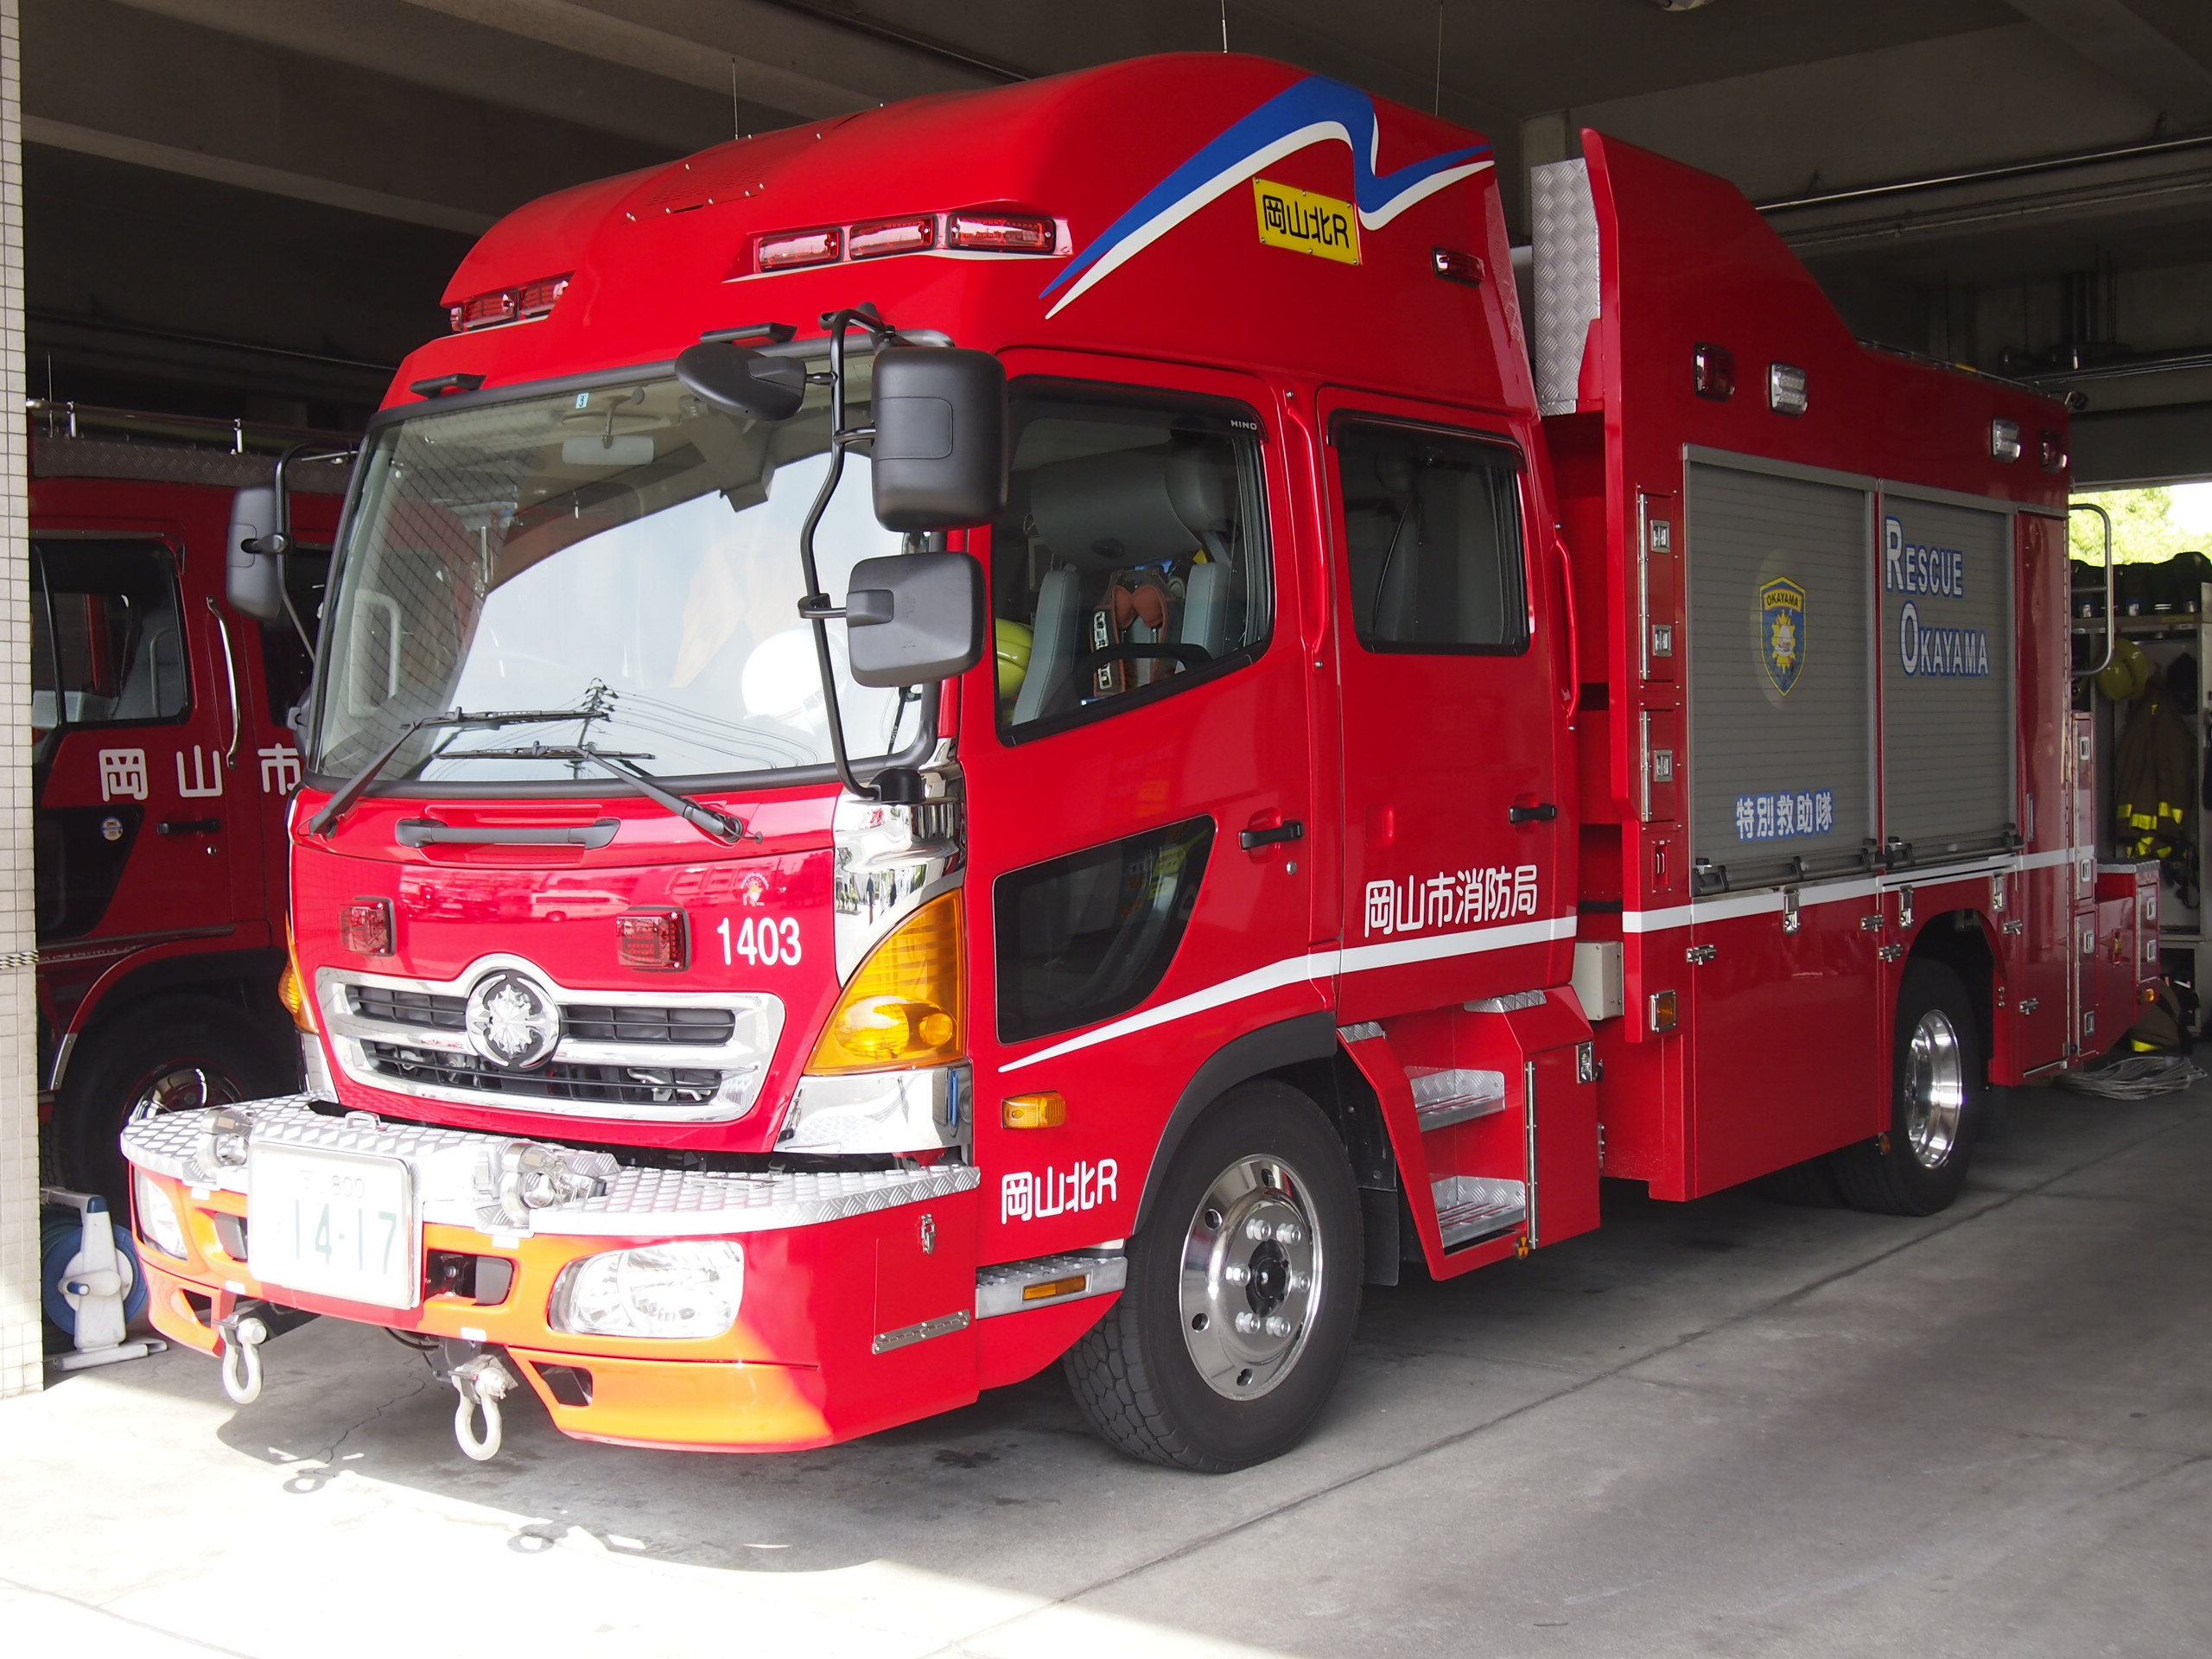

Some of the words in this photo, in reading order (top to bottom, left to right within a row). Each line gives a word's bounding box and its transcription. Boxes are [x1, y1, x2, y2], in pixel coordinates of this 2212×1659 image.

[1262, 194, 1350, 249] 岡山北R
[1230, 419, 1257, 430] HINO
[1766, 592, 1799, 607] OKAYAMA
[1736, 791, 1833, 840] 特別救助隊
[1363, 864, 1538, 938] 岡山市消防局
[716, 917, 802, 966] 1403
[332, 1174, 365, 1199] 800
[1001, 1158, 1118, 1225] 岡山北R
